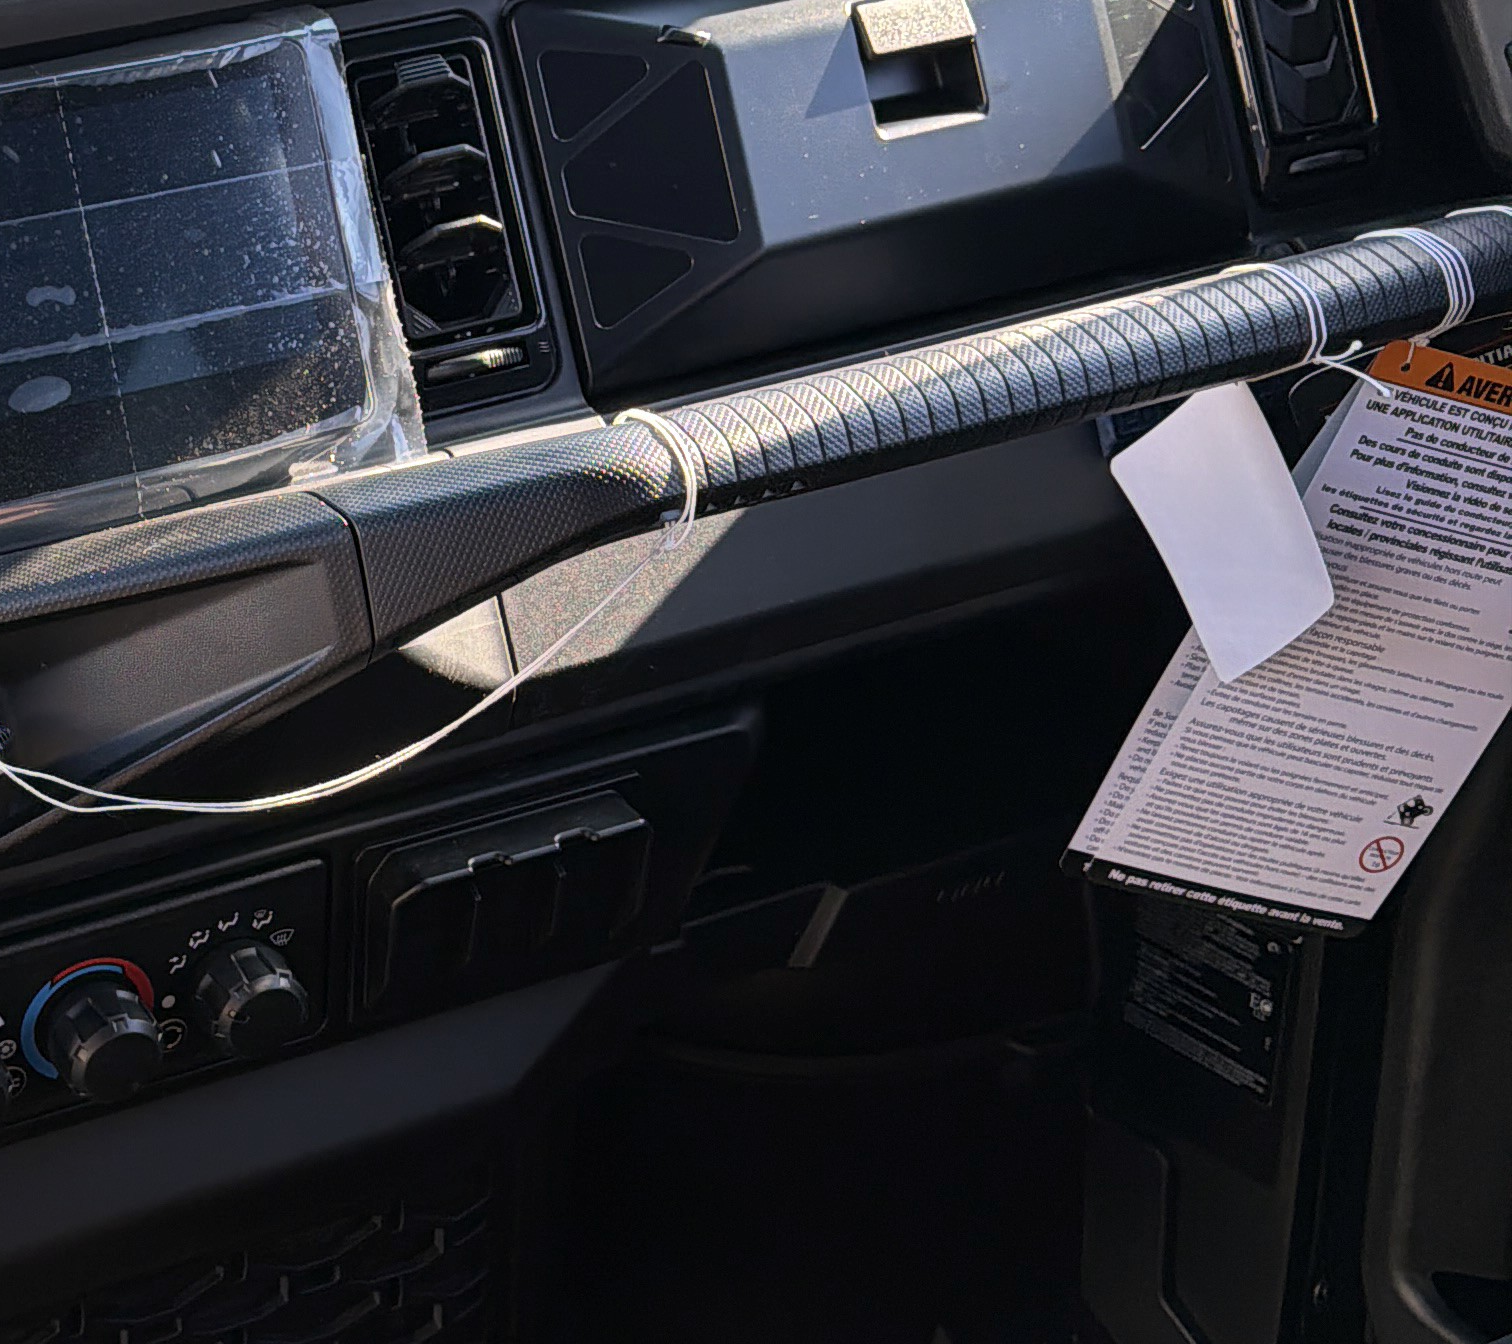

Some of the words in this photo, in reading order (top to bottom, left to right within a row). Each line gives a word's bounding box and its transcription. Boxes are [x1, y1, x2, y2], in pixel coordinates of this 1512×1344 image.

[1365, 399, 1391, 414] UNE
[1390, 406, 1461, 433] APPLICATION
[1447, 404, 1471, 418] EST
[1469, 410, 1510, 429] CONÇU
[1357, 434, 1378, 448] Des
[1378, 442, 1407, 456] cours
[1407, 448, 1421, 460] de
[1421, 454, 1463, 471] conduite
[1463, 464, 1487, 477] sont
[1404, 426, 1425, 441] Pas
[1424, 432, 1439, 445] de
[1439, 438, 1497, 459] conducteur
[1496, 452, 1512, 464] de
[1349, 448, 1374, 463] Pour
[1372, 456, 1395, 469] plus
[1461, 480, 1507, 498] consultez
[1320, 483, 1337, 495] les
[1338, 488, 1389, 508] étiquettes
[1390, 503, 1404, 513] de
[1405, 507, 1446, 523] sécurité
[1446, 518, 1459, 527] et
[1375, 485, 1402, 500] Lisez
[1402, 492, 1414, 503] le
[1413, 497, 1442, 510] guide
[1443, 504, 1457, 514] du
[1405, 478, 1451, 499] Visionnez
[1450, 491, 1462, 502] la
[1462, 495, 1489, 509] vidéo
[1488, 501, 1502, 513] de
[1326, 518, 1364, 537] locales
[1367, 532, 1428, 554] provinciales
[1428, 547, 1476, 565] régissant
[1329, 503, 1379, 525] Consultez
[1380, 518, 1407, 532] votre
[1406, 526, 1486, 552] concessionnaire
[1485, 546, 1511, 558] pour
[1107, 868, 1126, 882] Ne
[1124, 875, 1149, 887] pas
[1148, 880, 1187, 896] retirer
[1185, 889, 1217, 903] cette
[1217, 896, 1268, 914] étiquette
[1267, 908, 1300, 921] avant
[1298, 912, 1312, 924] la
